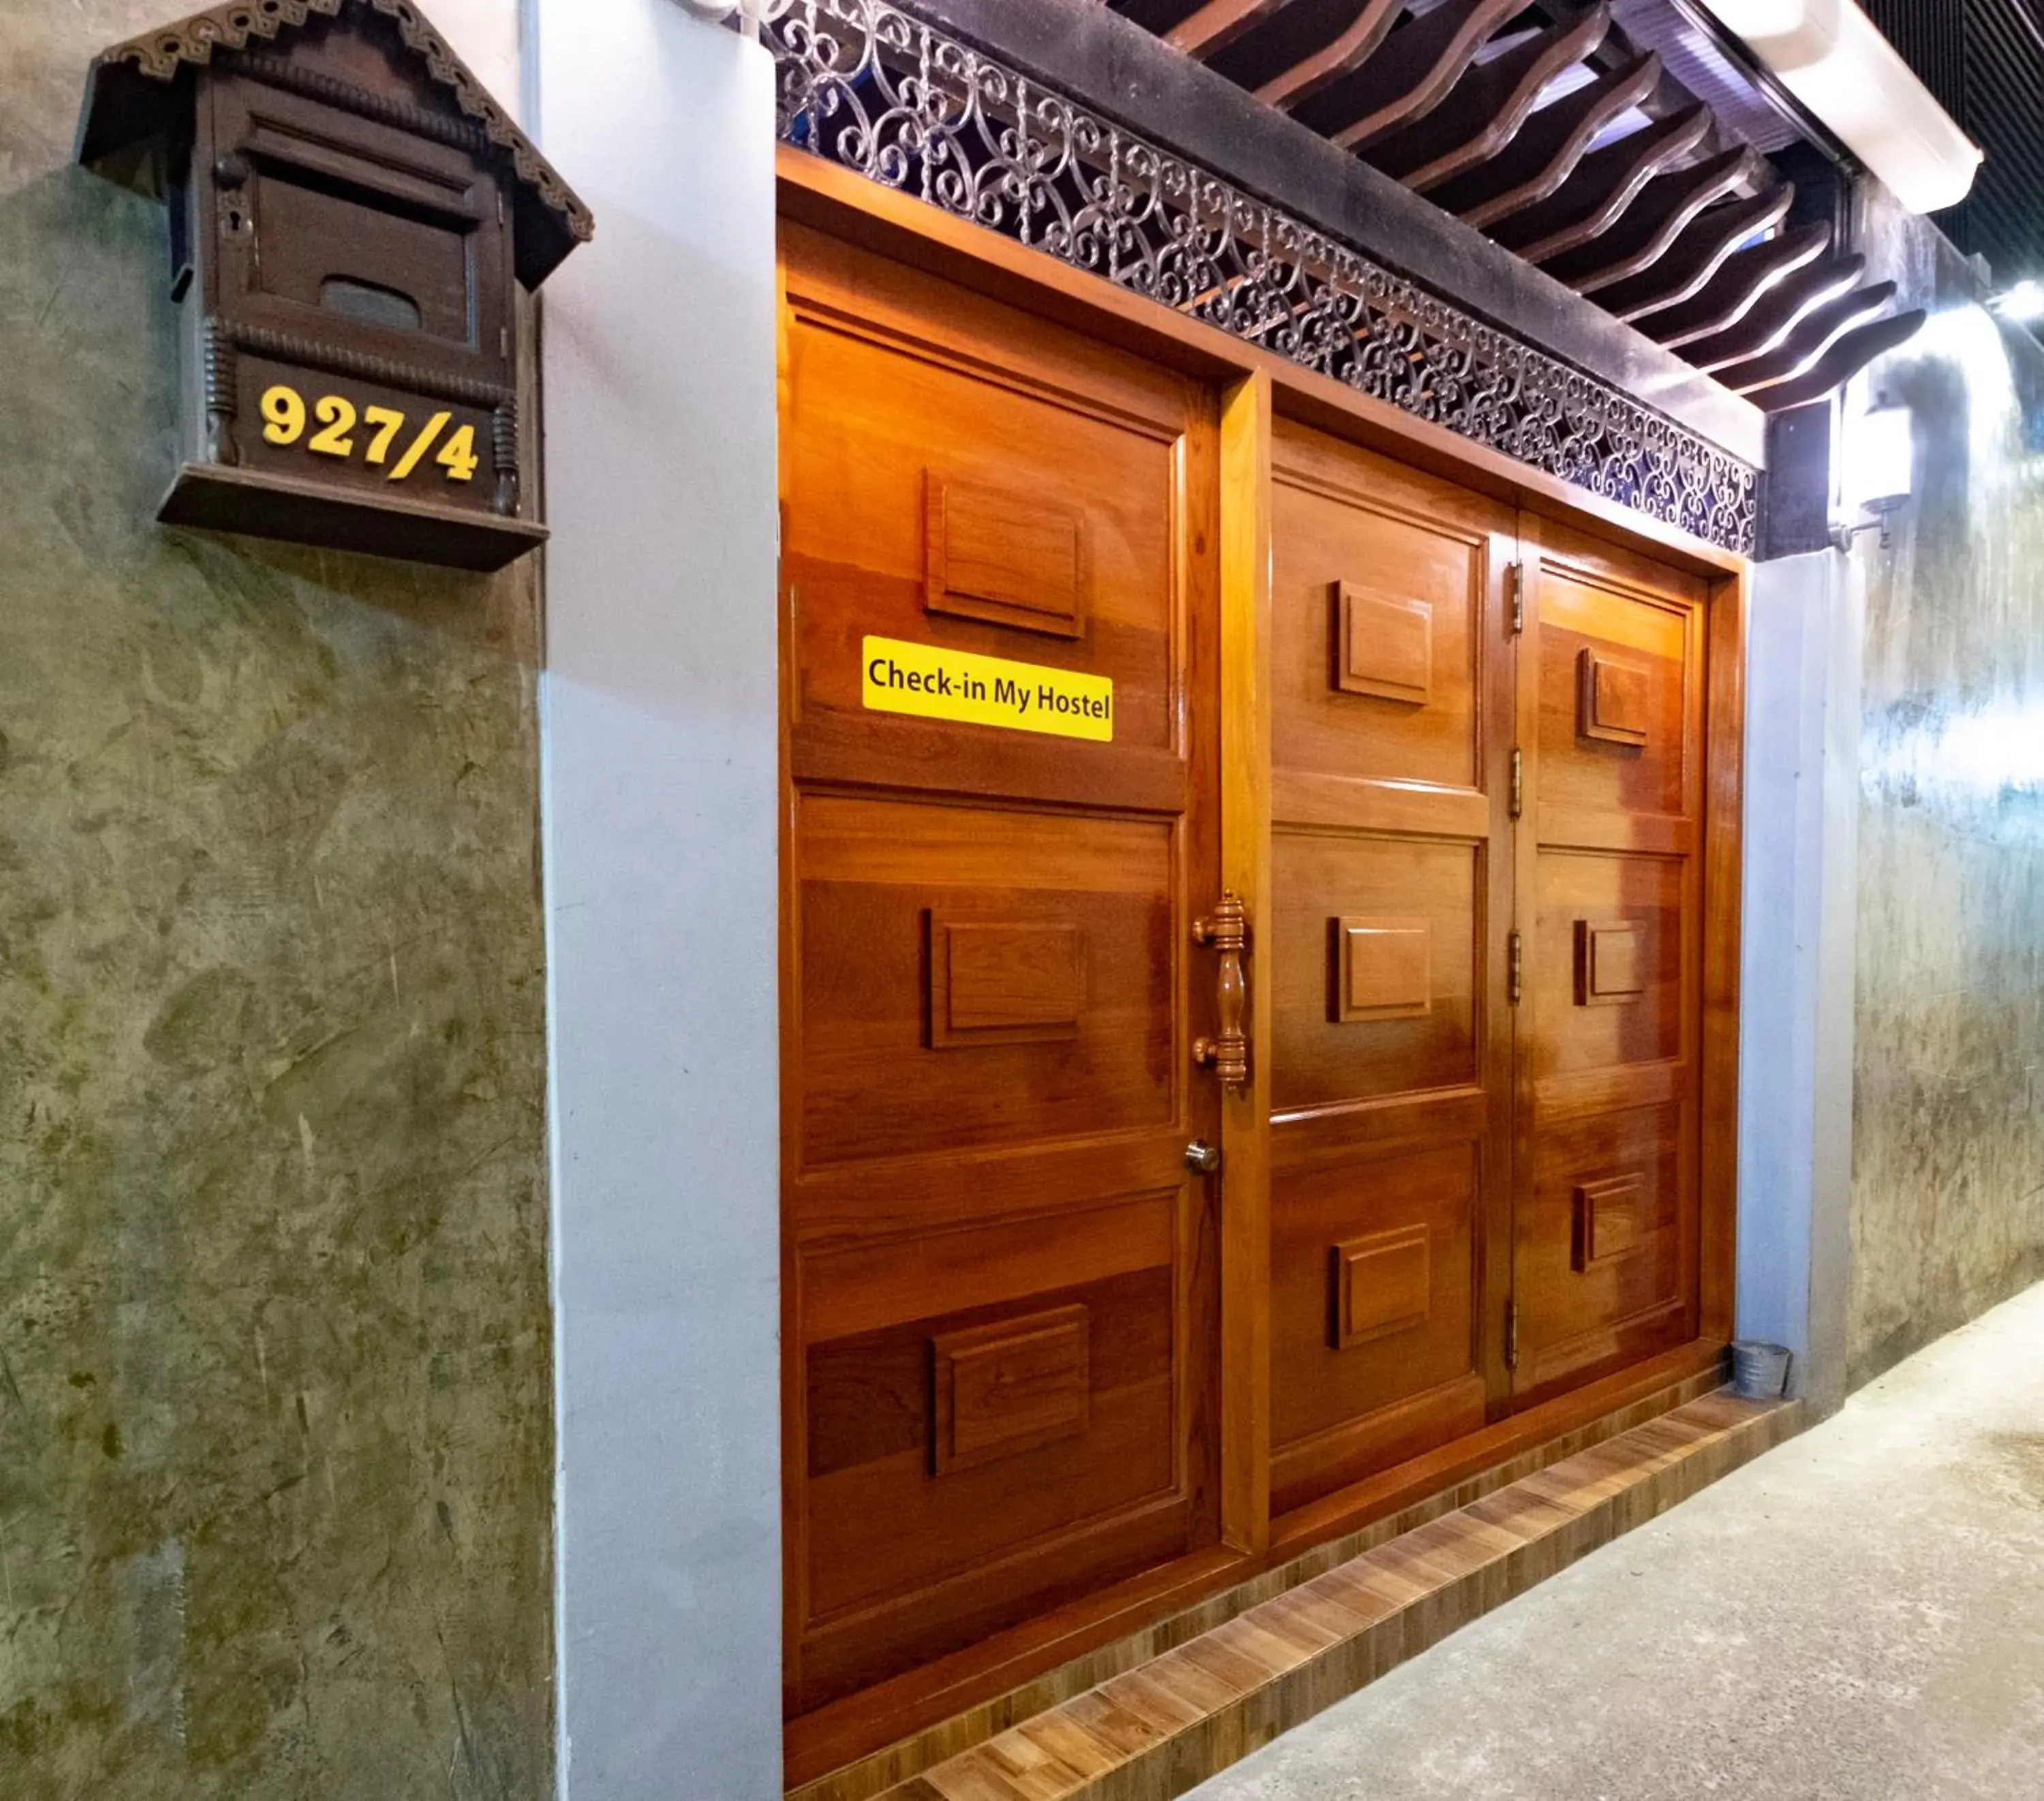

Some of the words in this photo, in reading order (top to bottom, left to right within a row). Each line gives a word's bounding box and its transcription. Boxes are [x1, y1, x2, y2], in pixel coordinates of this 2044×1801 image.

[260, 385, 479, 481] 927/4
[868, 659, 986, 701] Check-in
[994, 678, 1031, 713] My
[1038, 685, 1110, 719] Hostel
